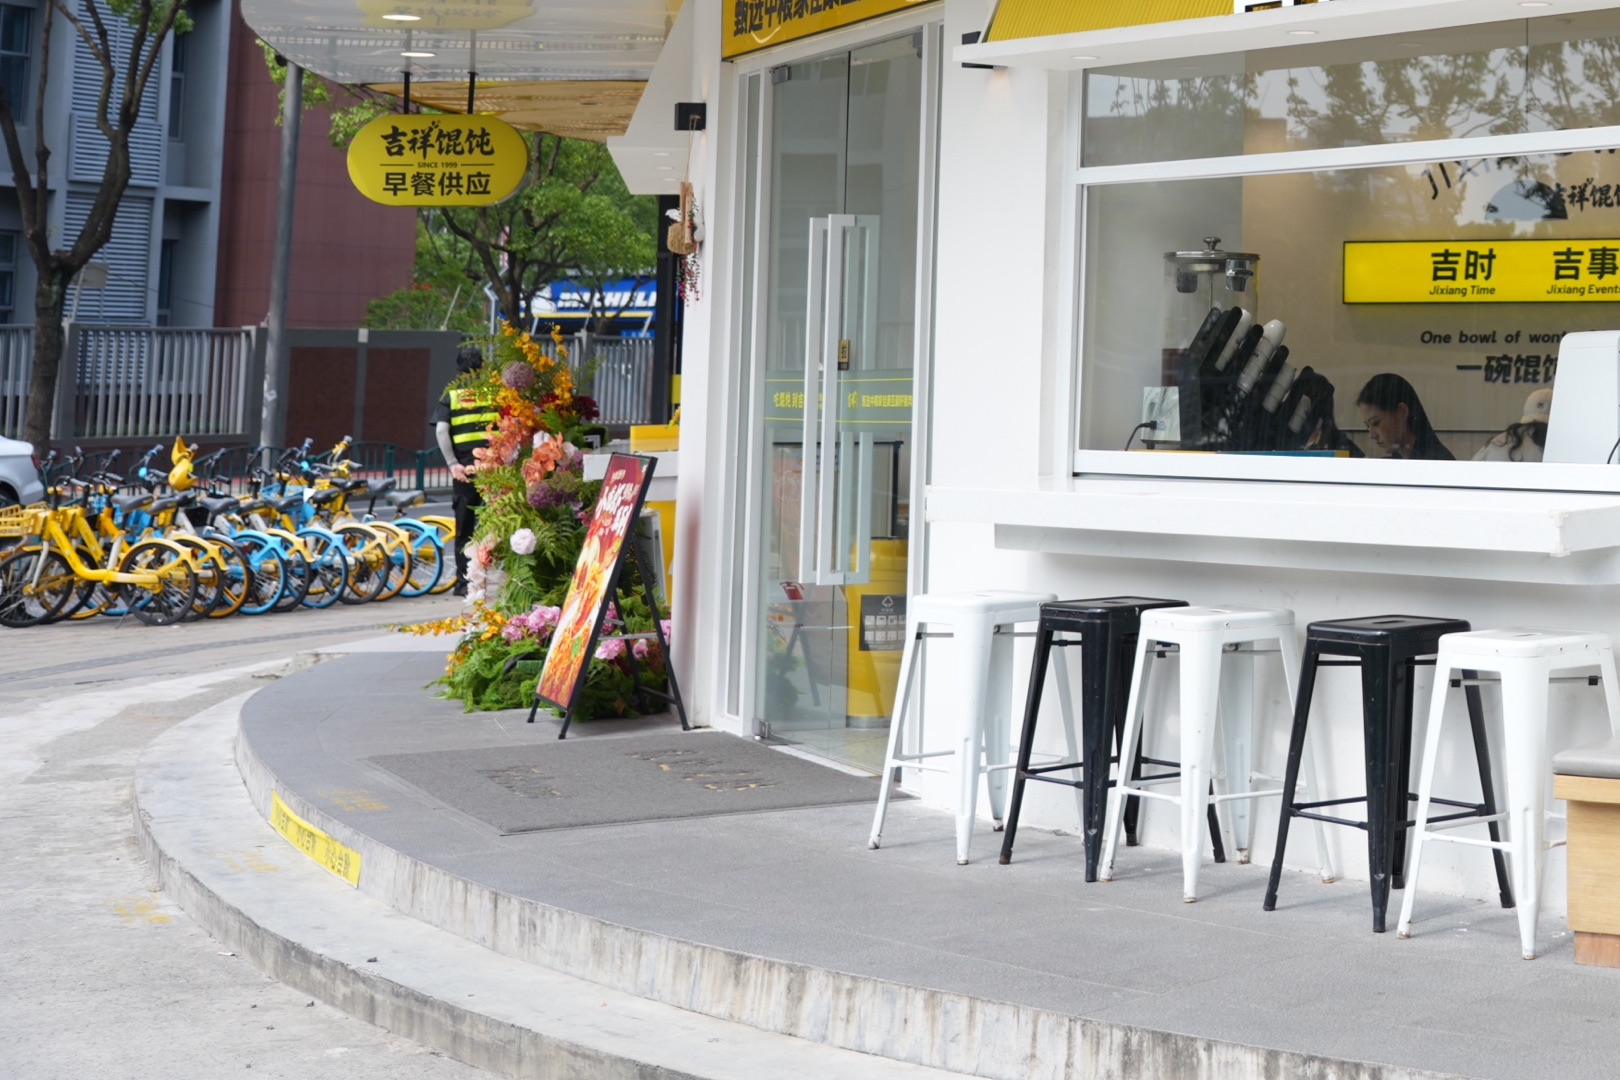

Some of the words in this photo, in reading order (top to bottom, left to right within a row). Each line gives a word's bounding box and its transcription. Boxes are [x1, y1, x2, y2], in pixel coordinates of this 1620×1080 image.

[381, 120, 495, 160] 吉祥馄饨
[383, 172, 491, 196] 早餐供应
[1431, 248, 1496, 281] 吉时
[1553, 247, 1620, 280] 吉事
[1429, 285, 1468, 296] Jixiang
[1470, 286, 1496, 295] Time
[1547, 285, 1585, 296] Jixiang
[1420, 331, 1452, 344] One
[1459, 330, 1497, 344] bowl
[1504, 330, 1521, 344] of
